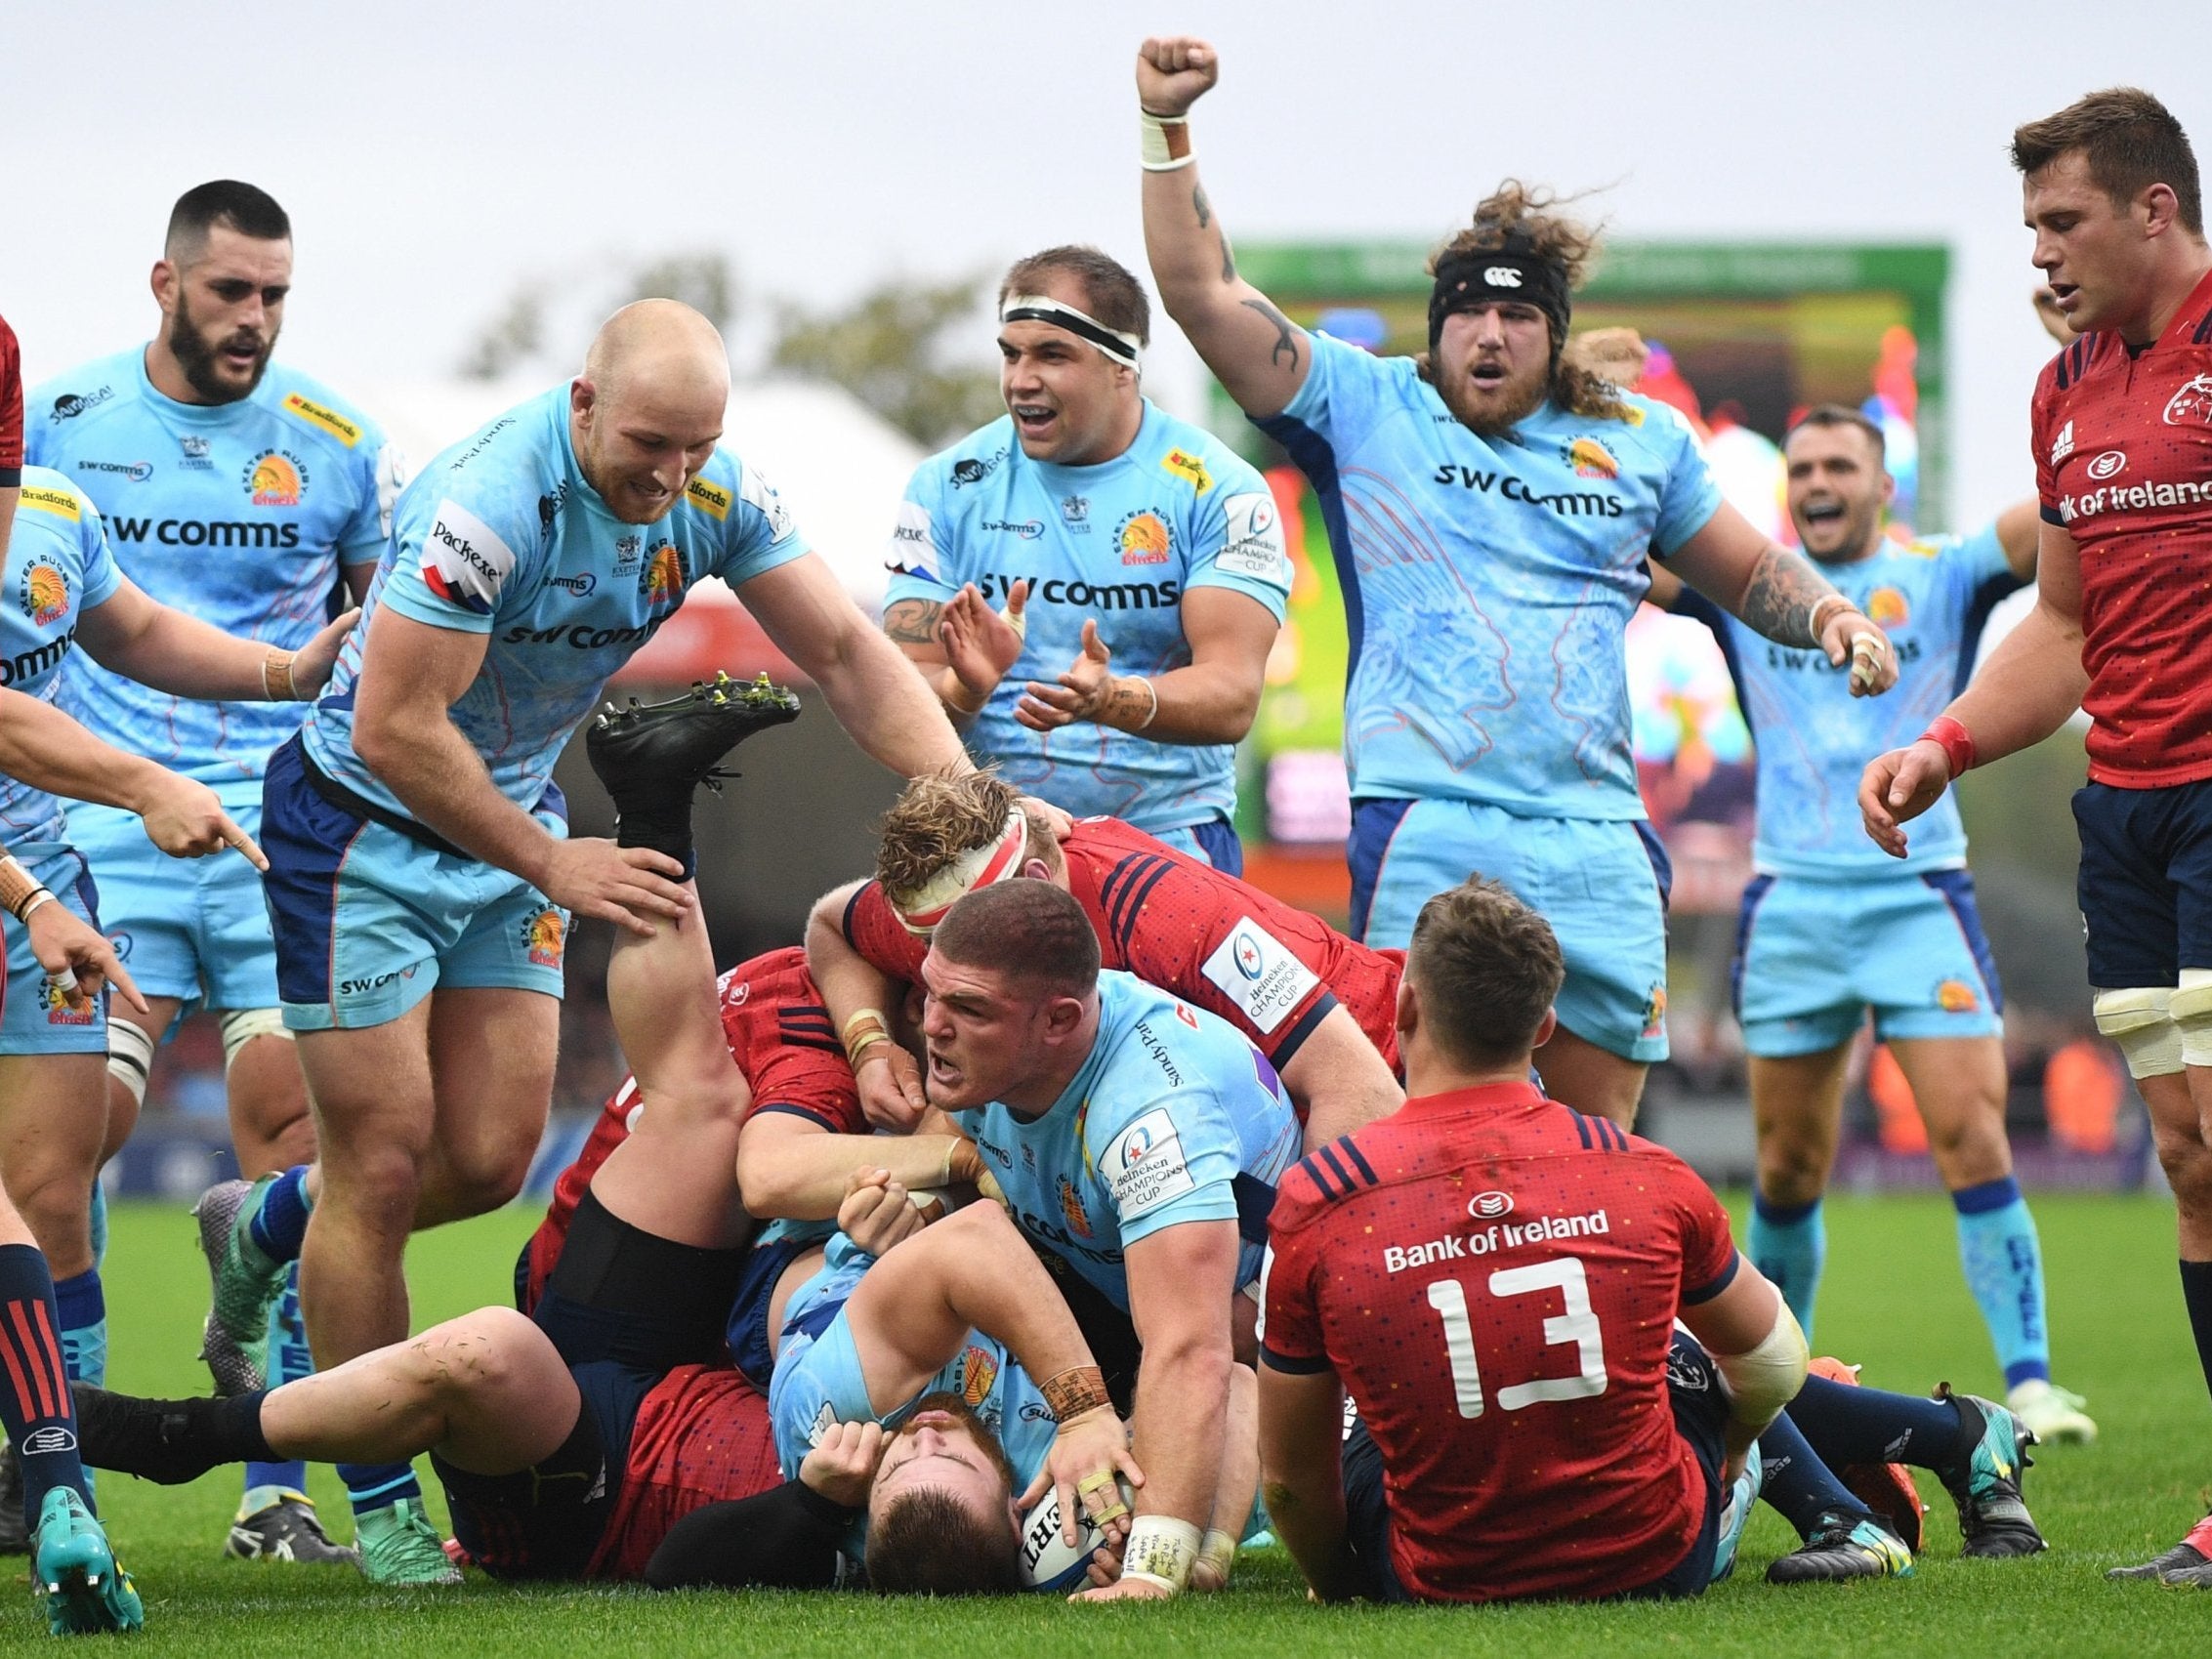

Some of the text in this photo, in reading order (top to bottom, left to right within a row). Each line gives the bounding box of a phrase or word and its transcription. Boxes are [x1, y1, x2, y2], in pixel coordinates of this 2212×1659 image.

[301, 402, 355, 437] Bradfords
[242, 448, 310, 494] EXETER RUGBY
[21, 489, 77, 511] Bradfords
[2080, 487, 2108, 517] of
[20, 555, 70, 618] EXETER RUGBY
[1249, 960, 1288, 1001] Heineken
[1277, 984, 1297, 1007] CUP
[1151, 1046, 1185, 1088] Sandy
[1115, 1164, 1184, 1201] CHAMPIONS
[1136, 1185, 1160, 1205] CUP
[1383, 1209, 1609, 1273] Bank of Ireland
[1428, 1257, 1607, 1419] 13
